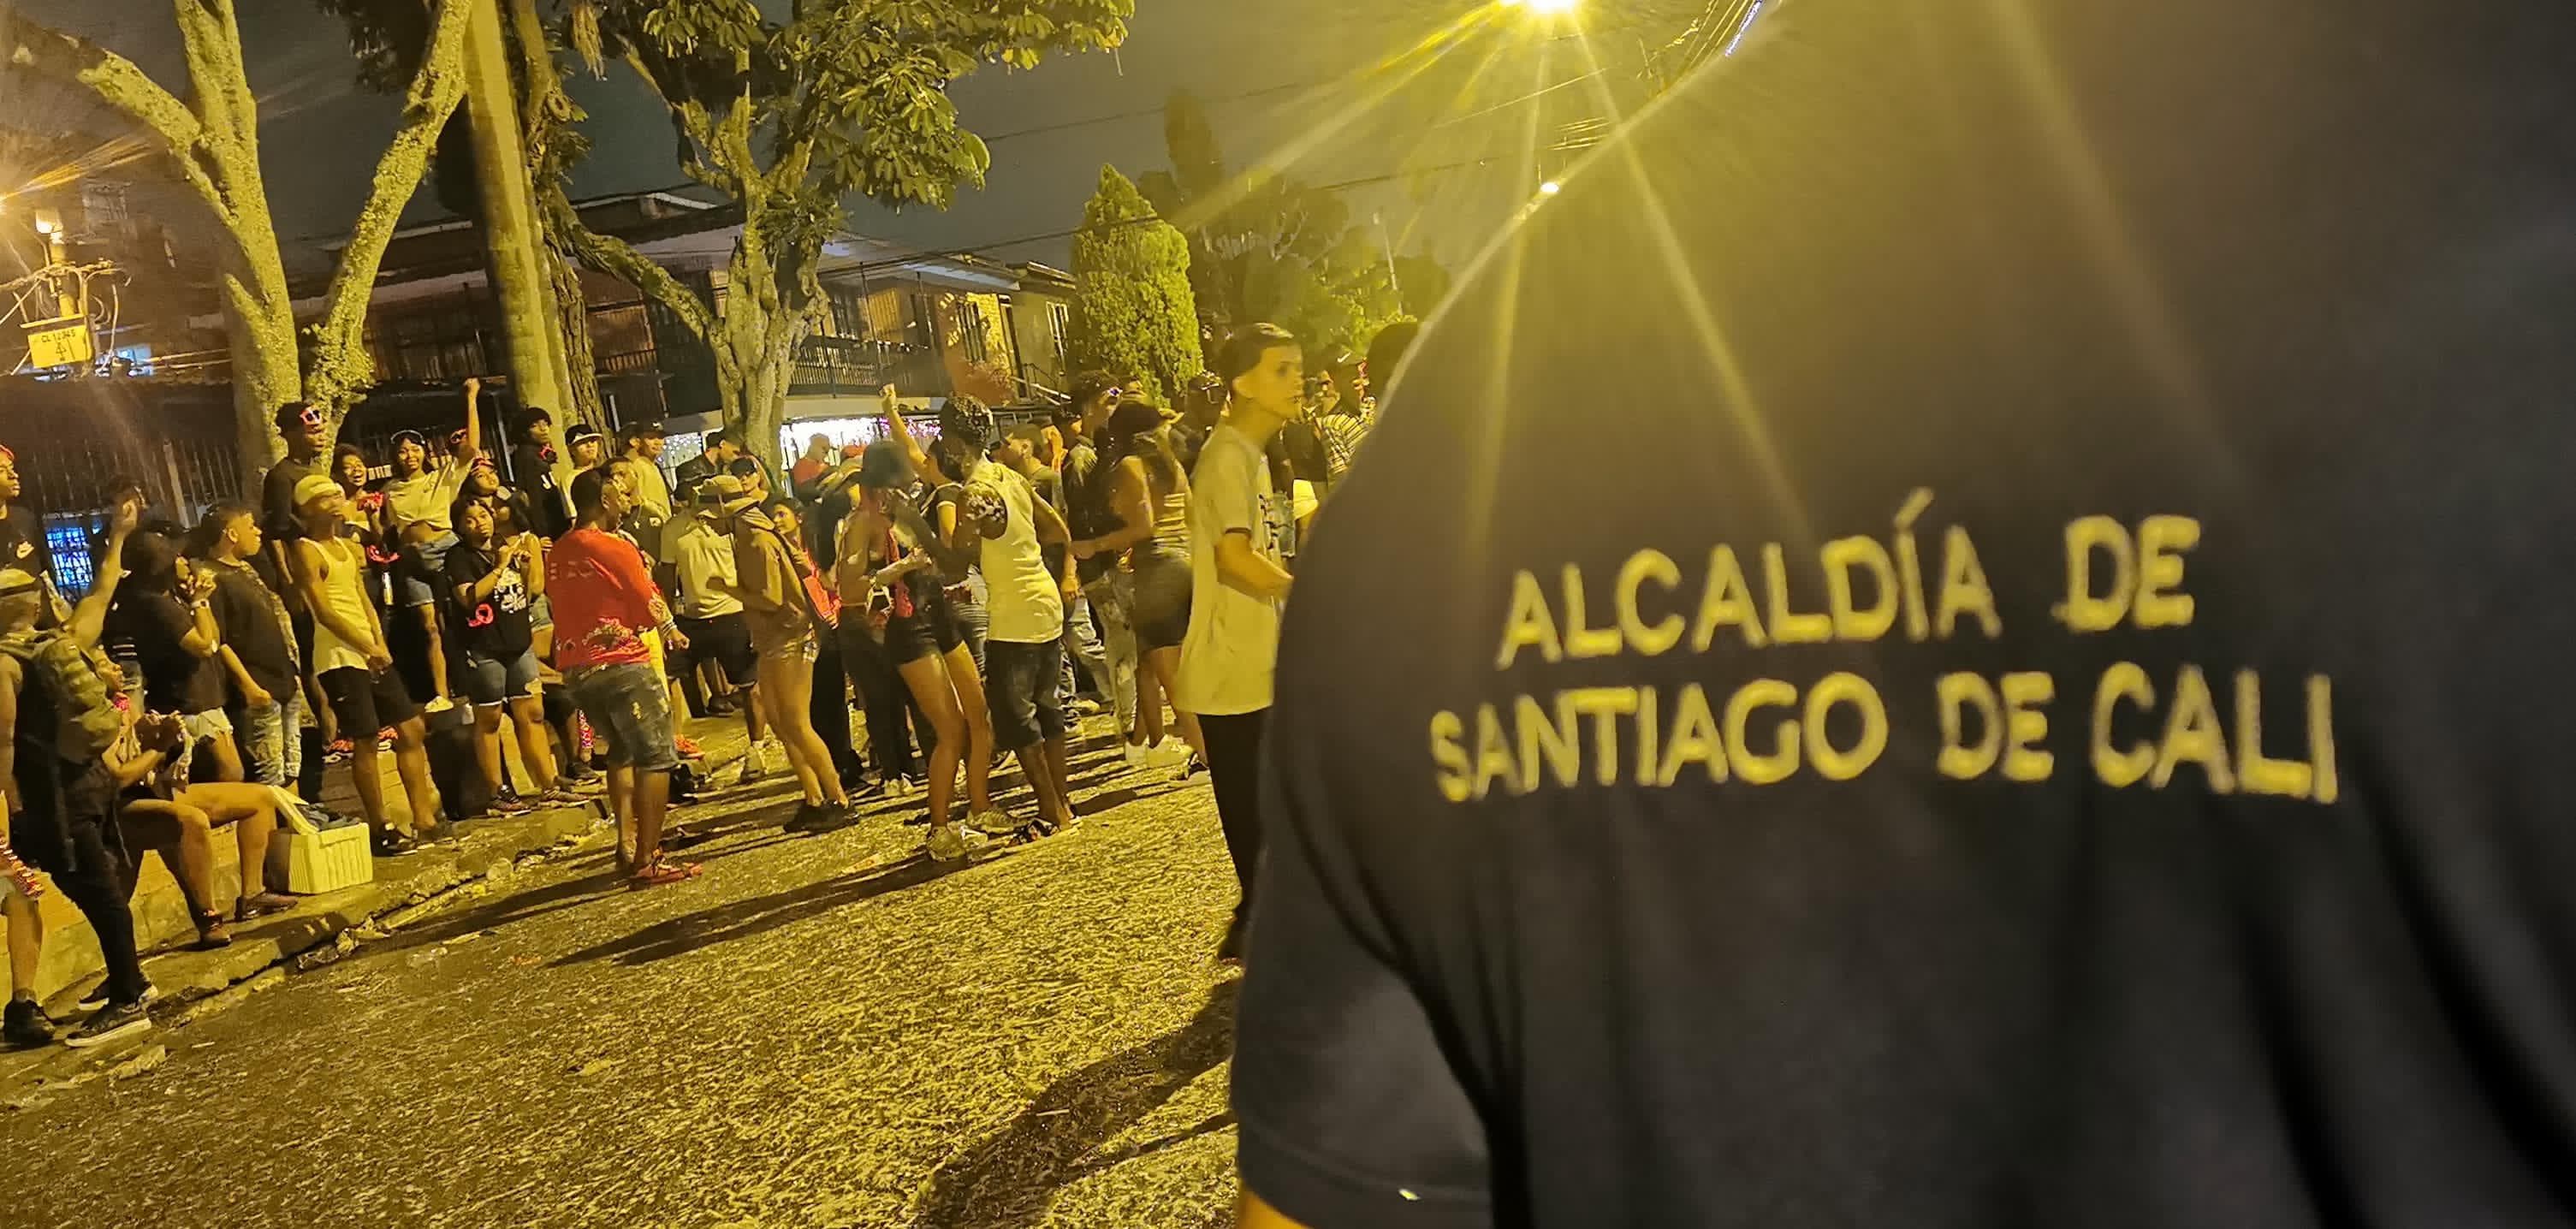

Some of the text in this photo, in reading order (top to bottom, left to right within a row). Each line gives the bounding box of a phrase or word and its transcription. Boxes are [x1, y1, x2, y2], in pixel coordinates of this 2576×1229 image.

[1498, 487, 2201, 670] ALCALDÍA DE
[1429, 661, 2339, 803] SANTIAGO DE CALI
